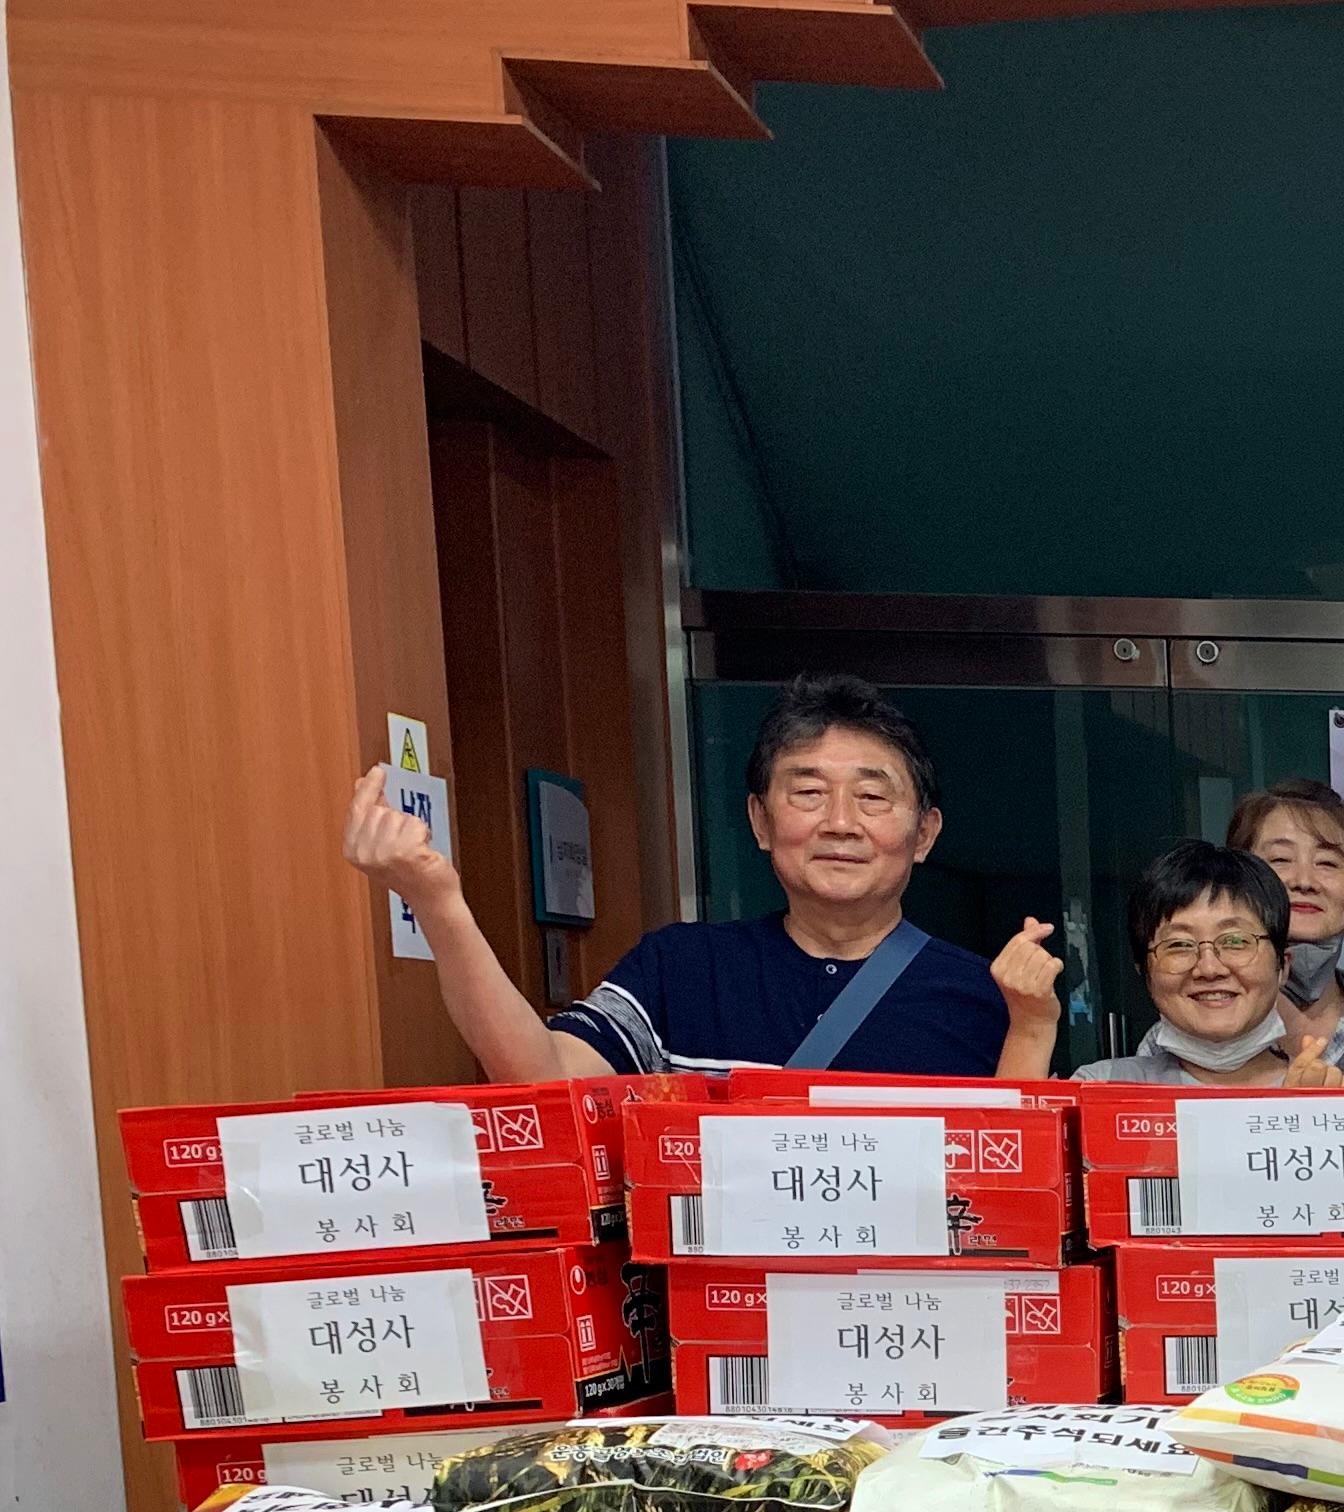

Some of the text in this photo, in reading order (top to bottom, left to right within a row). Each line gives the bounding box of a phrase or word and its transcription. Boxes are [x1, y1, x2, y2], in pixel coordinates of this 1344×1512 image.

[294, 1116, 407, 1146] 글로벌 나눔
[1245, 1112, 1306, 1134] 글로벌
[771, 1131, 880, 1154] 글로벌 나눔
[299, 1149, 415, 1195] 대성사
[772, 1162, 883, 1203] 대성사
[306, 1283, 407, 1310] 글로벌 나눔
[837, 1291, 942, 1313] 글로벌 나눔
[309, 1314, 416, 1356] 대성사
[837, 1321, 946, 1362] 대성사
